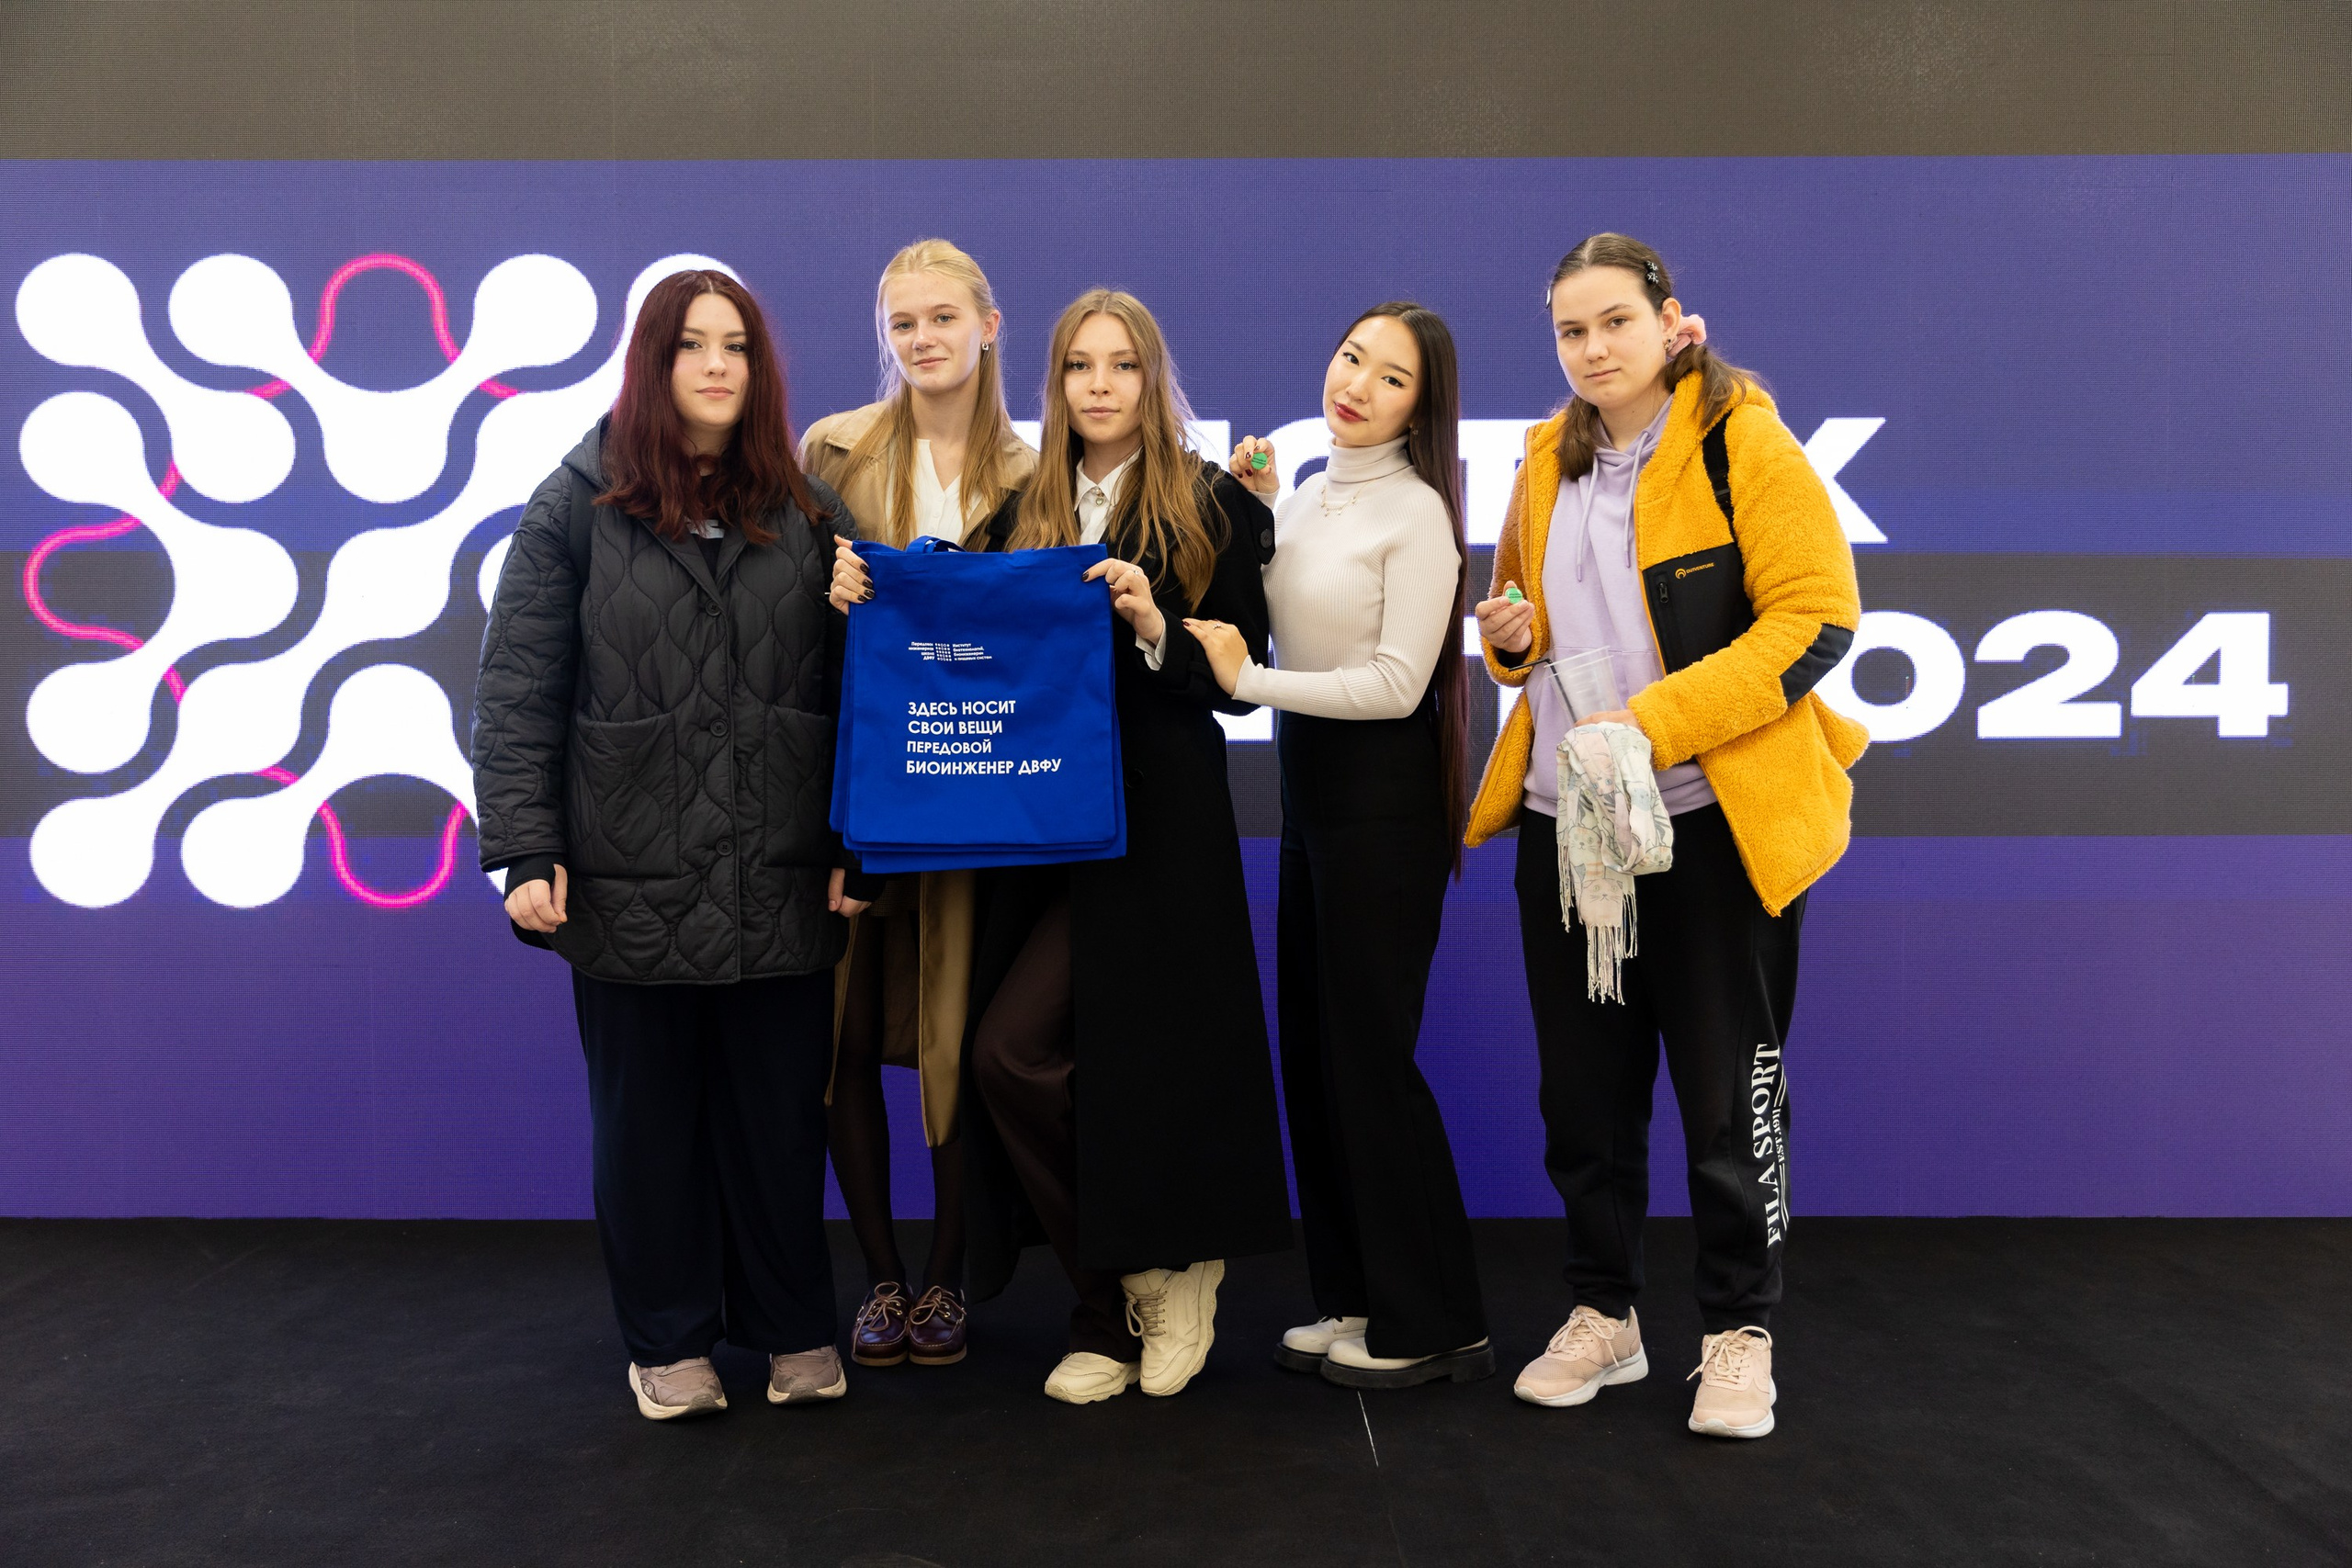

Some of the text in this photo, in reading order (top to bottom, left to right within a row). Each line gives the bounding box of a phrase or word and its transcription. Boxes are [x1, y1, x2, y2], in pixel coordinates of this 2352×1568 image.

[1686, 562, 1714, 573] OUTVENTURE
[909, 701, 1016, 716] ЗДЕСЬ НОСИТ
[908, 720, 1003, 736] СВОИ ВЕЩИ
[907, 739, 992, 755] ПЕРЕДОВОЙ
[906, 758, 1062, 775] БИОИНЖЕНЕР ДВФУ
[1751, 1043, 1781, 1248] FILA SPORT
